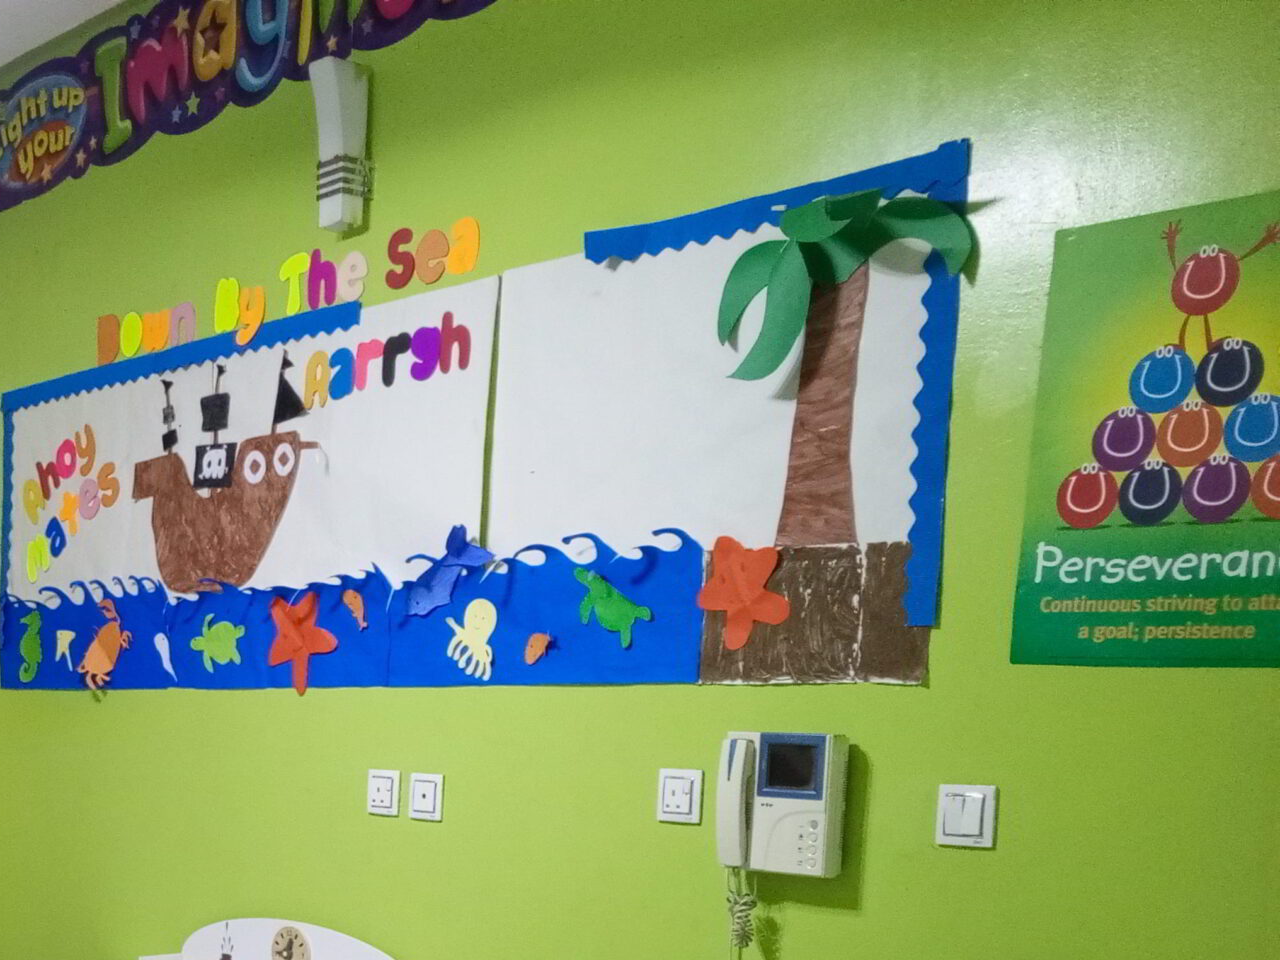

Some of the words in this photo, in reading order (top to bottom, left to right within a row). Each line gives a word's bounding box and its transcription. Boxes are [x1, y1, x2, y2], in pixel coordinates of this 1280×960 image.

[52, 87, 84, 113] up
[17, 125, 75, 181] your
[97, 301, 197, 367] Down
[214, 276, 266, 347] By
[279, 247, 370, 316] The
[385, 215, 481, 290] Sea
[303, 311, 472, 409] Aarrgh
[1034, 541, 1280, 584] Perseveran
[1039, 595, 1142, 613] Continuous
[1146, 594, 1217, 615] striving
[1222, 595, 1243, 611] to
[1077, 626, 1089, 639] a
[1092, 622, 1140, 643] goal;
[1142, 621, 1257, 643] persistence
